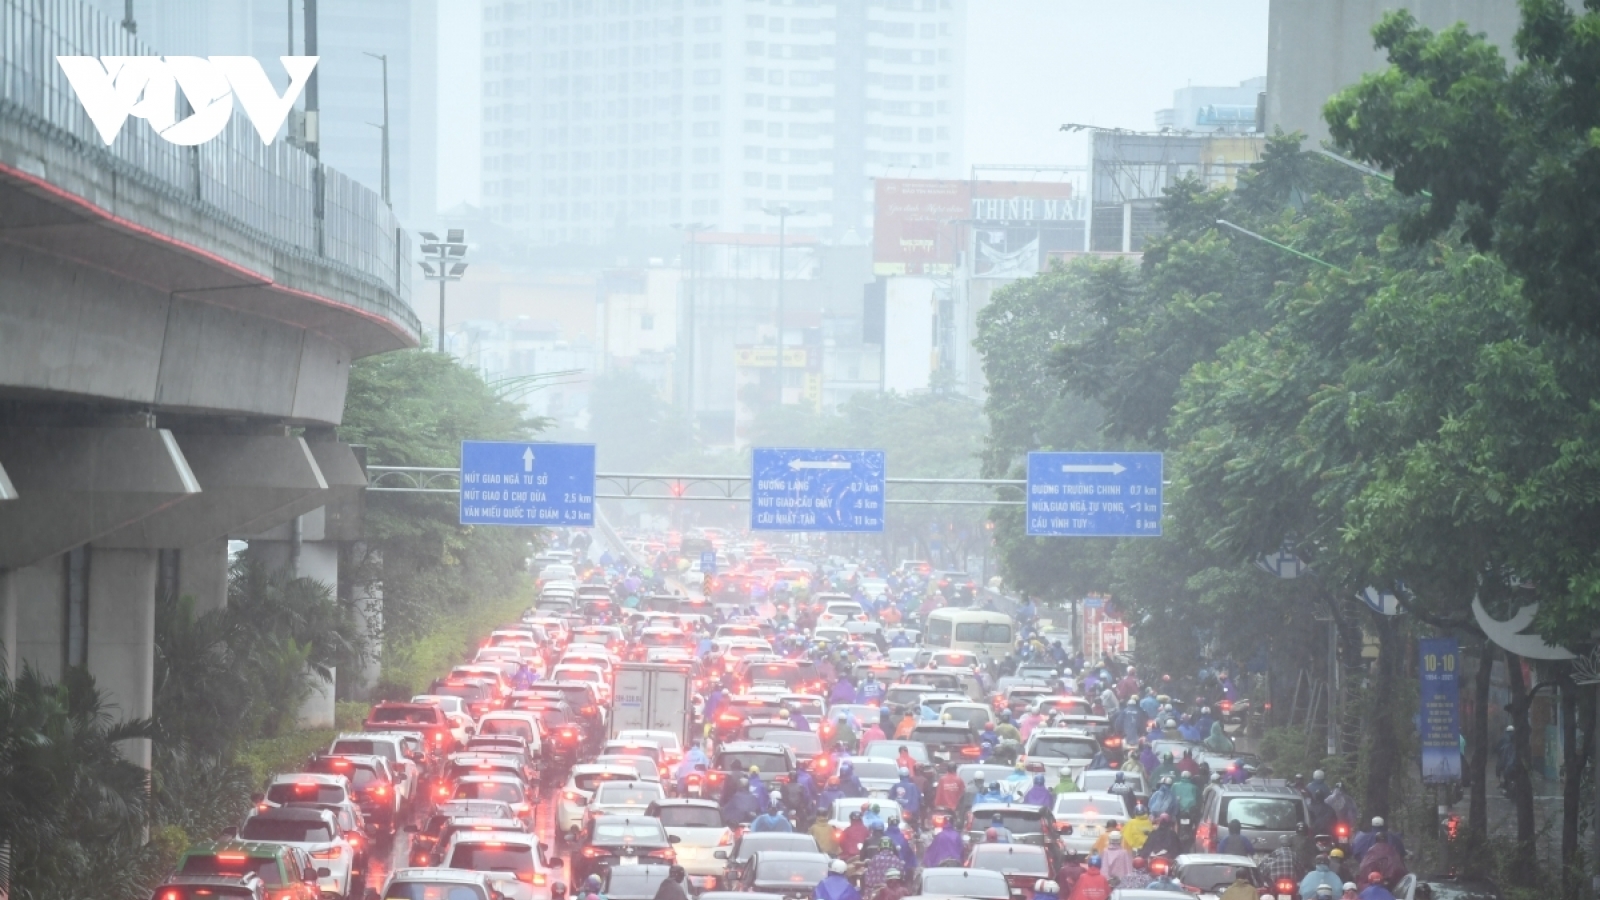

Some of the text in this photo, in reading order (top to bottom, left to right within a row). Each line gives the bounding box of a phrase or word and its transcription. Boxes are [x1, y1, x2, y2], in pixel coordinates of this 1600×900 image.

[464, 471, 548, 484] NÚT GIAO NGÃ TƯ SỞ
[865, 483, 878, 492] km
[1063, 482, 1094, 495] TRƯỜNG
[1097, 485, 1120, 495] CHINH
[1144, 486, 1156, 495] km
[464, 487, 480, 500] NÚT
[482, 491, 500, 500] GIAO
[504, 489, 508, 500] Ô
[512, 492, 527, 503] CHỢ
[579, 493, 591, 503] km
[758, 492, 773, 507] NÚT
[776, 498, 794, 507] GIAO
[865, 499, 878, 508] km
[1050, 502, 1068, 511] GIAO
[1144, 503, 1156, 512] km
[464, 505, 480, 516] VĂN
[482, 504, 501, 517] MIẾU
[504, 505, 524, 518] QUỐC
[539, 507, 559, 518] GIÁM
[579, 510, 591, 520] km
[758, 511, 772, 524] CẦU
[855, 516, 877, 525] 11 km
[1032, 516, 1047, 528] CẦU
[1072, 519, 1087, 528] TUY
[1144, 520, 1156, 529] km
